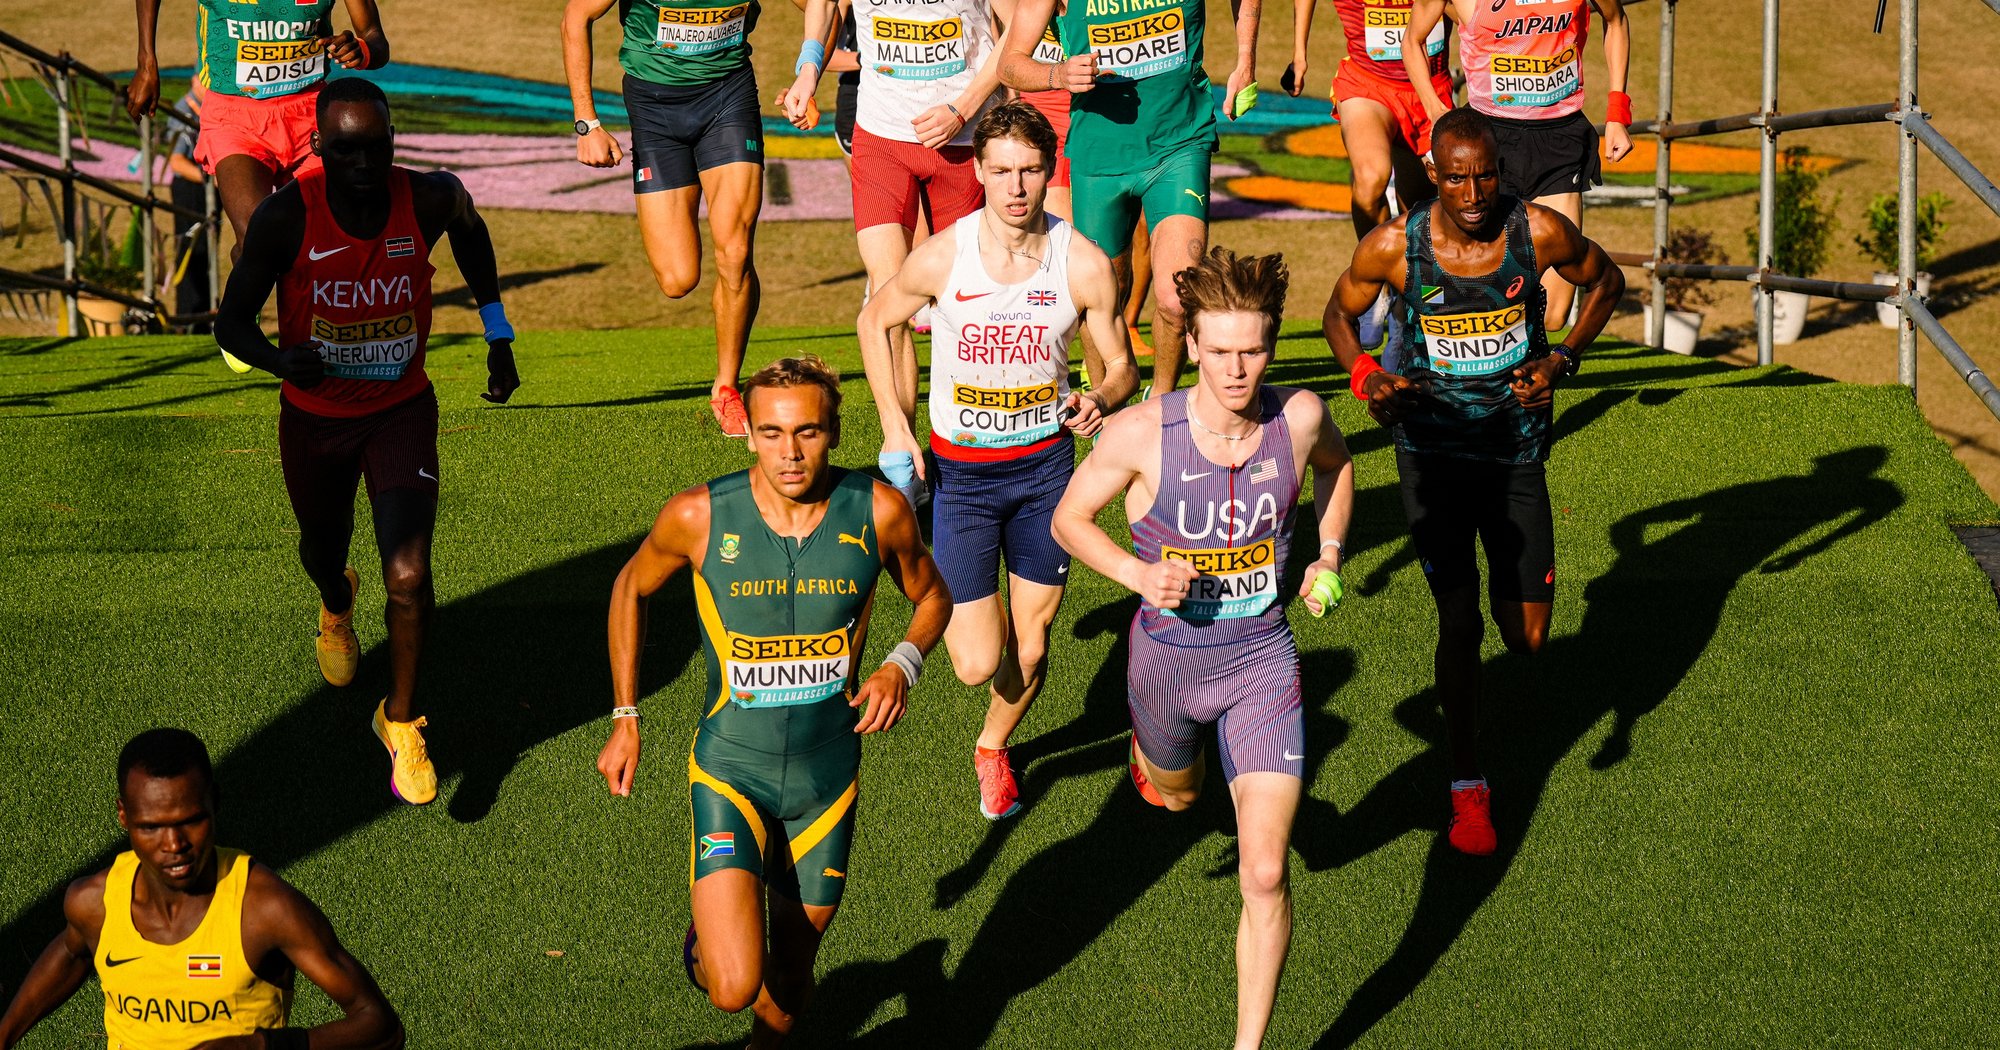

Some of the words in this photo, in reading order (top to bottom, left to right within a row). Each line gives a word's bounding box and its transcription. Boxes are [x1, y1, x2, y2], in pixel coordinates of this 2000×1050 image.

[663, 6, 744, 24] SEIKO
[1367, 11, 1411, 26] SEI
[1495, 12, 1573, 39] JAPAN
[661, 27, 705, 42] TINAJERO
[706, 21, 742, 41] ÁLVAREZ
[875, 21, 958, 41] SEIKO
[1091, 13, 1180, 44] SEIKO
[241, 41, 321, 62] SEIKO
[877, 41, 959, 64] MALLECK
[1098, 34, 1180, 66] HOARE
[1493, 48, 1574, 73] SEIKO
[246, 58, 316, 83] ADISU
[897, 65, 949, 77] TALLAHASSEE
[951, 63, 961, 72] 26
[1120, 58, 1172, 78] TALLAHASSEE
[1175, 56, 1184, 65] 26
[1495, 65, 1574, 92] SHIOBARA
[1518, 88, 1567, 103] TALLAHASSEE
[313, 275, 413, 308] KENYA
[315, 315, 413, 342] SEIKO
[962, 323, 1049, 345] GREAT
[1424, 308, 1522, 336] SEIKO
[320, 339, 414, 364] CHERUIYOT
[958, 340, 1051, 364] BRITAIN
[1436, 331, 1518, 359] SINDA
[1456, 353, 1514, 372] TALLAHASSEE
[1516, 345, 1526, 356] 26
[957, 386, 1054, 409] SEIKO
[960, 404, 1051, 432] COUTTIE
[1177, 492, 1277, 541] USA
[729, 579, 787, 597] SOUTH
[796, 578, 858, 595] AFRICA
[731, 634, 844, 660] SEIKO
[733, 660, 842, 687] MUNNIK
[760, 687, 827, 703] TALLAHASSEE
[831, 681, 843, 692] 26
[107, 990, 232, 1024] UGANDA
